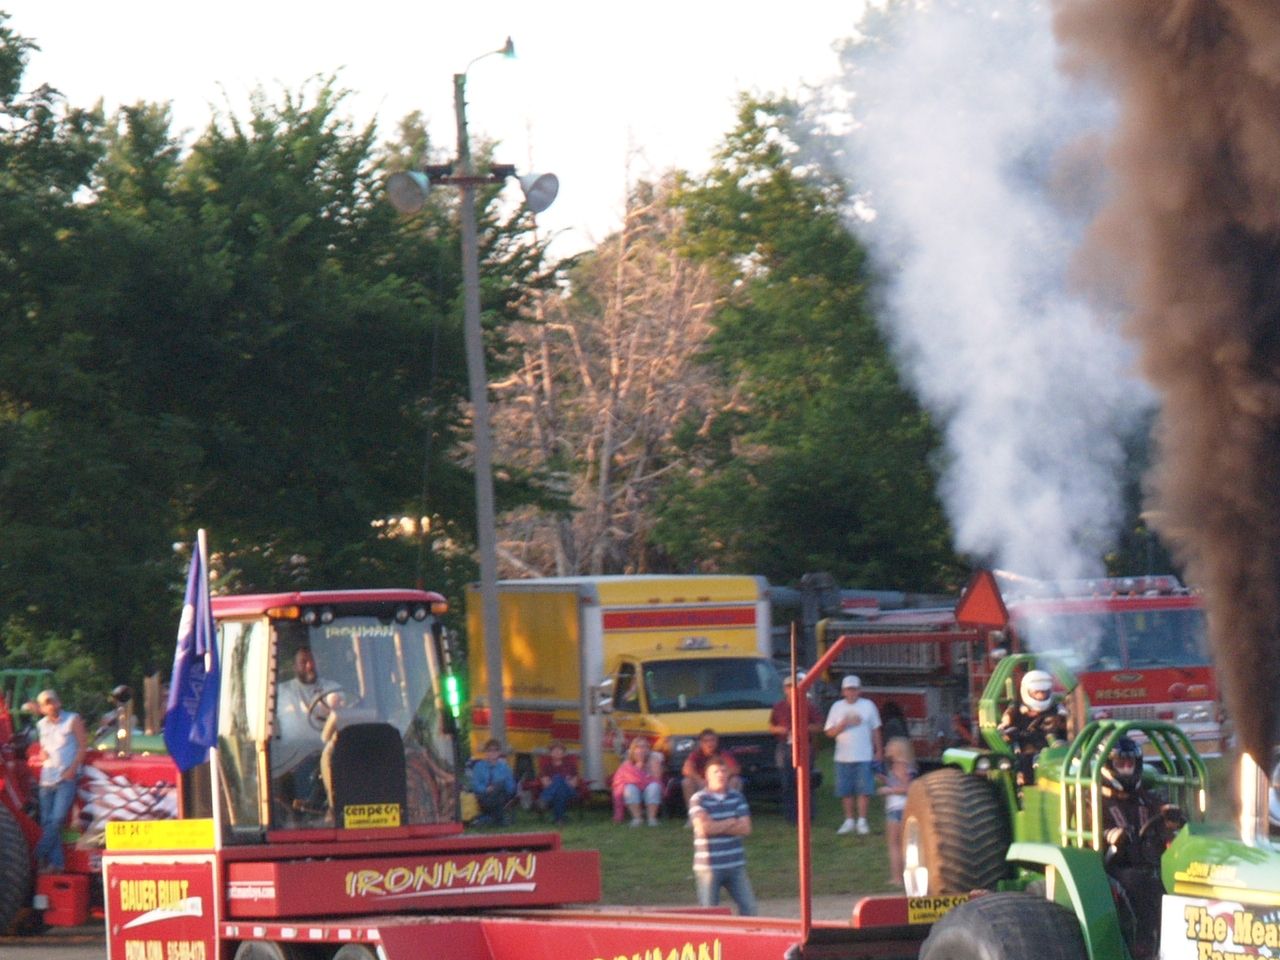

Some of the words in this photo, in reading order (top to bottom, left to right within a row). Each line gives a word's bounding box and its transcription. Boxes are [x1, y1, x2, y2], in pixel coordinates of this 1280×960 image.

[1096, 688, 1147, 699] RESCUE
[346, 852, 537, 897] IRONMAN
[120, 880, 157, 912] BAUER
[158, 880, 189, 912] BUILT
[1184, 905, 1228, 942] The
